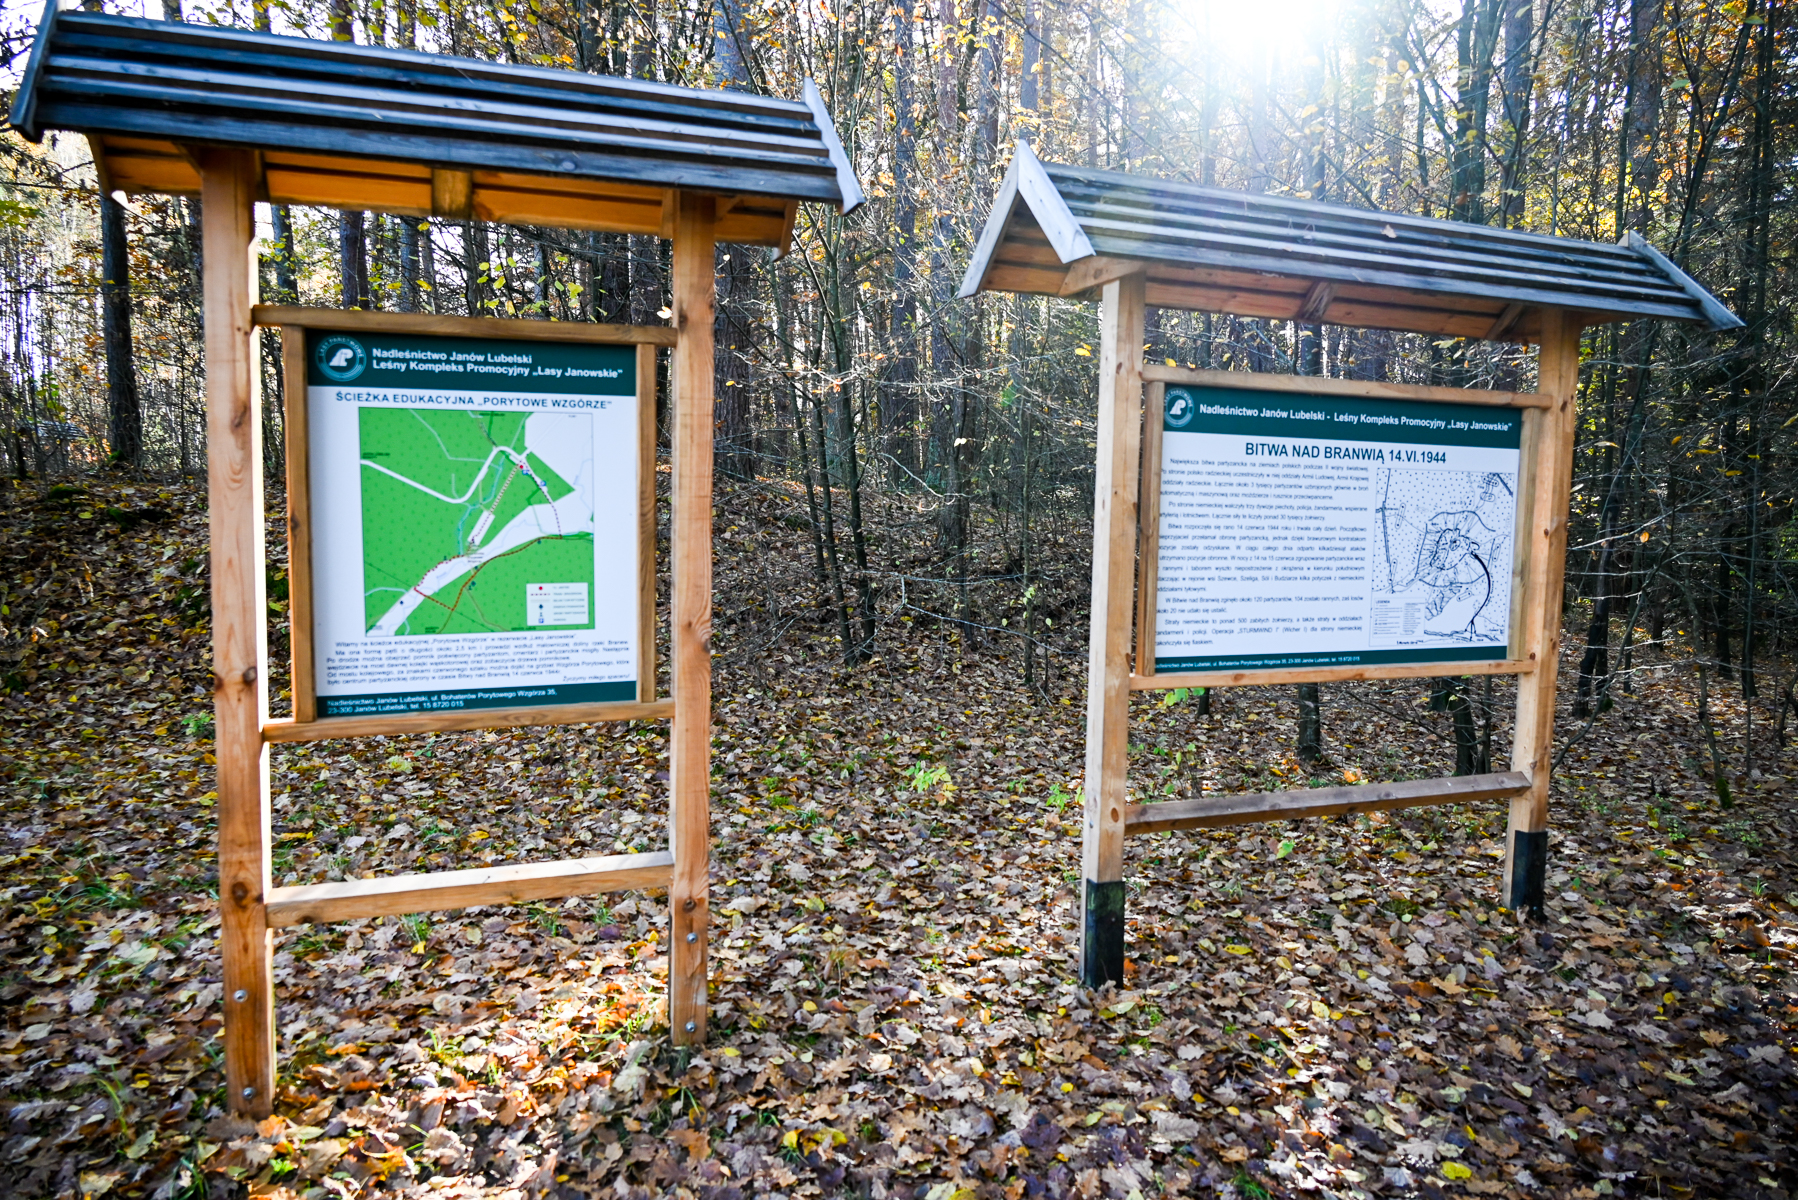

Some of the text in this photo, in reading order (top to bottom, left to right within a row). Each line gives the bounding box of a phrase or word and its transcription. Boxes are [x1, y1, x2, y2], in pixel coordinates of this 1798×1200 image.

[372, 348, 532, 364] Nadleśnictwo Janów Lubelski
[373, 360, 406, 373] Leśny
[409, 361, 464, 374] Kompleks
[467, 364, 529, 376] Promocyjny
[335, 391, 389, 403] ŚCIEŻKA
[393, 394, 475, 405] EDUKACYJNA
[1199, 404, 1259, 417] Nadleśnictwo
[1260, 408, 1288, 418] Janów
[1290, 410, 1325, 421] Lubelski
[1334, 412, 1358, 424] Leśny
[1360, 414, 1399, 426] Kompleks
[1400, 416, 1446, 429] Promocyjny
[1245, 442, 1446, 464] BITWA NAD BRANWIĄ 14.VI.1944
